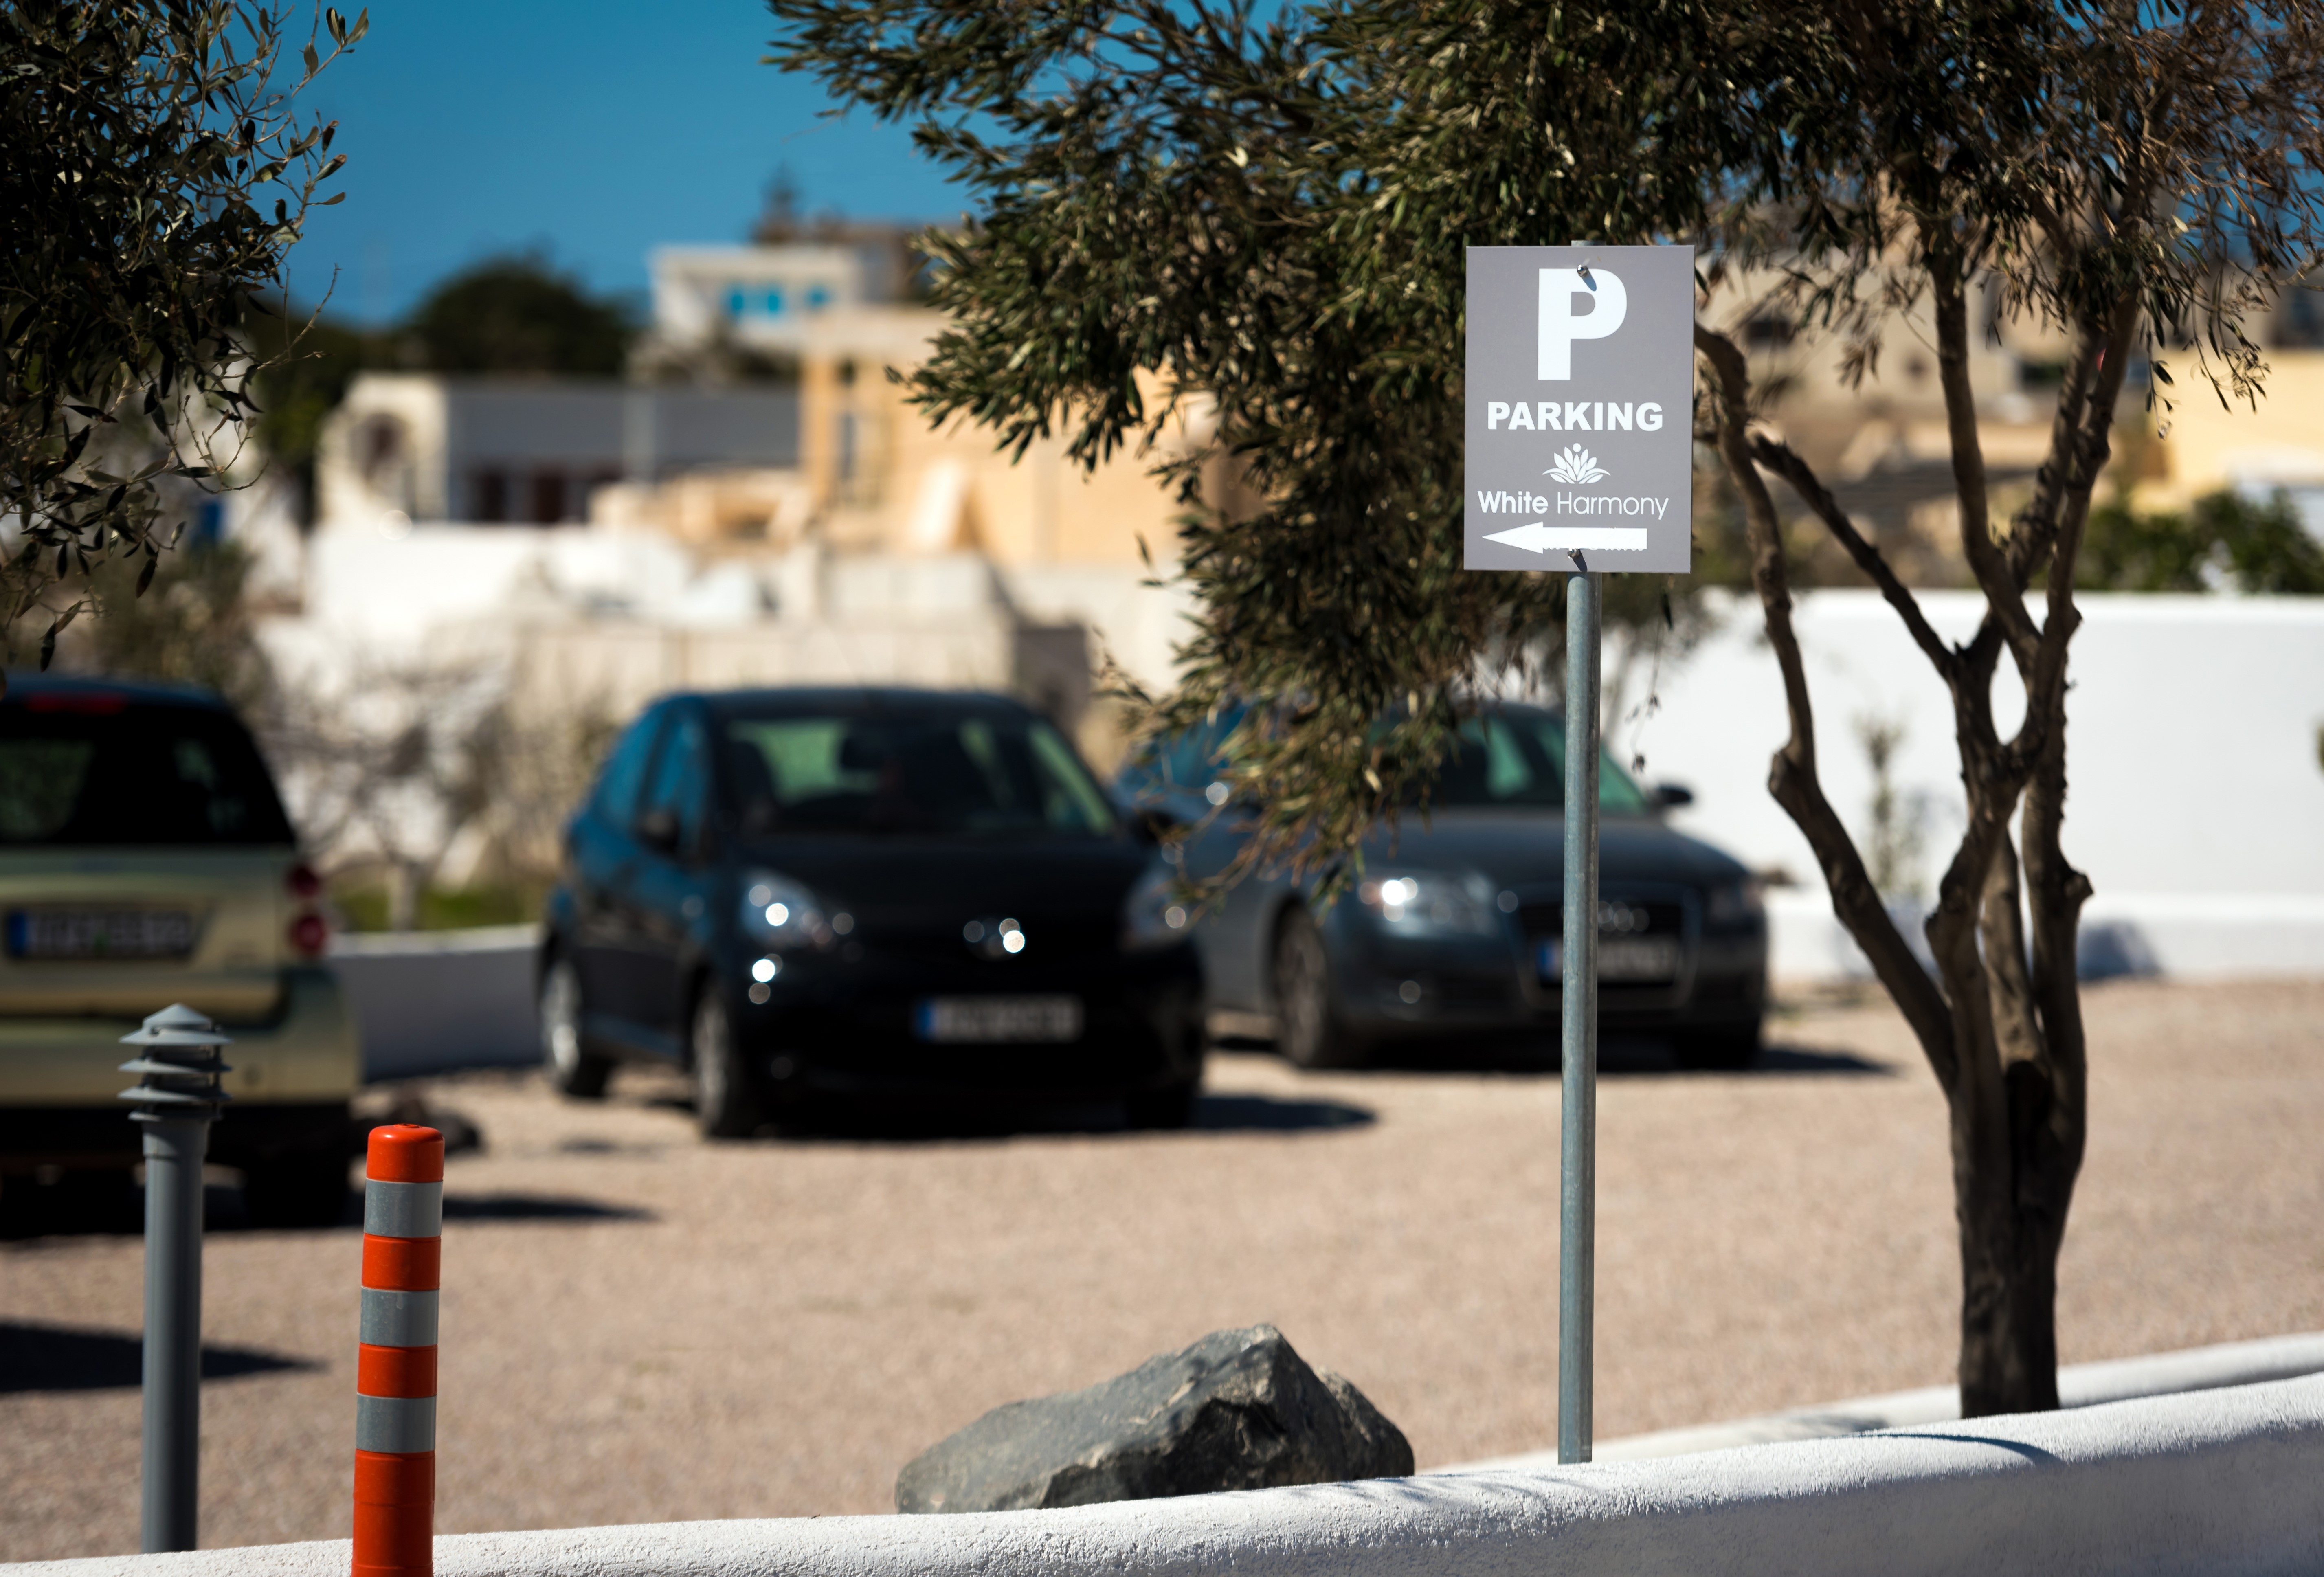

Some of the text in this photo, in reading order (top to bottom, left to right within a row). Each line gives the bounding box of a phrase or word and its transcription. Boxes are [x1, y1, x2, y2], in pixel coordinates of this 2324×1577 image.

[1538, 268, 1627, 381] P
[1488, 401, 1663, 431] PARKING
[1477, 490, 1669, 520] White Harmony
